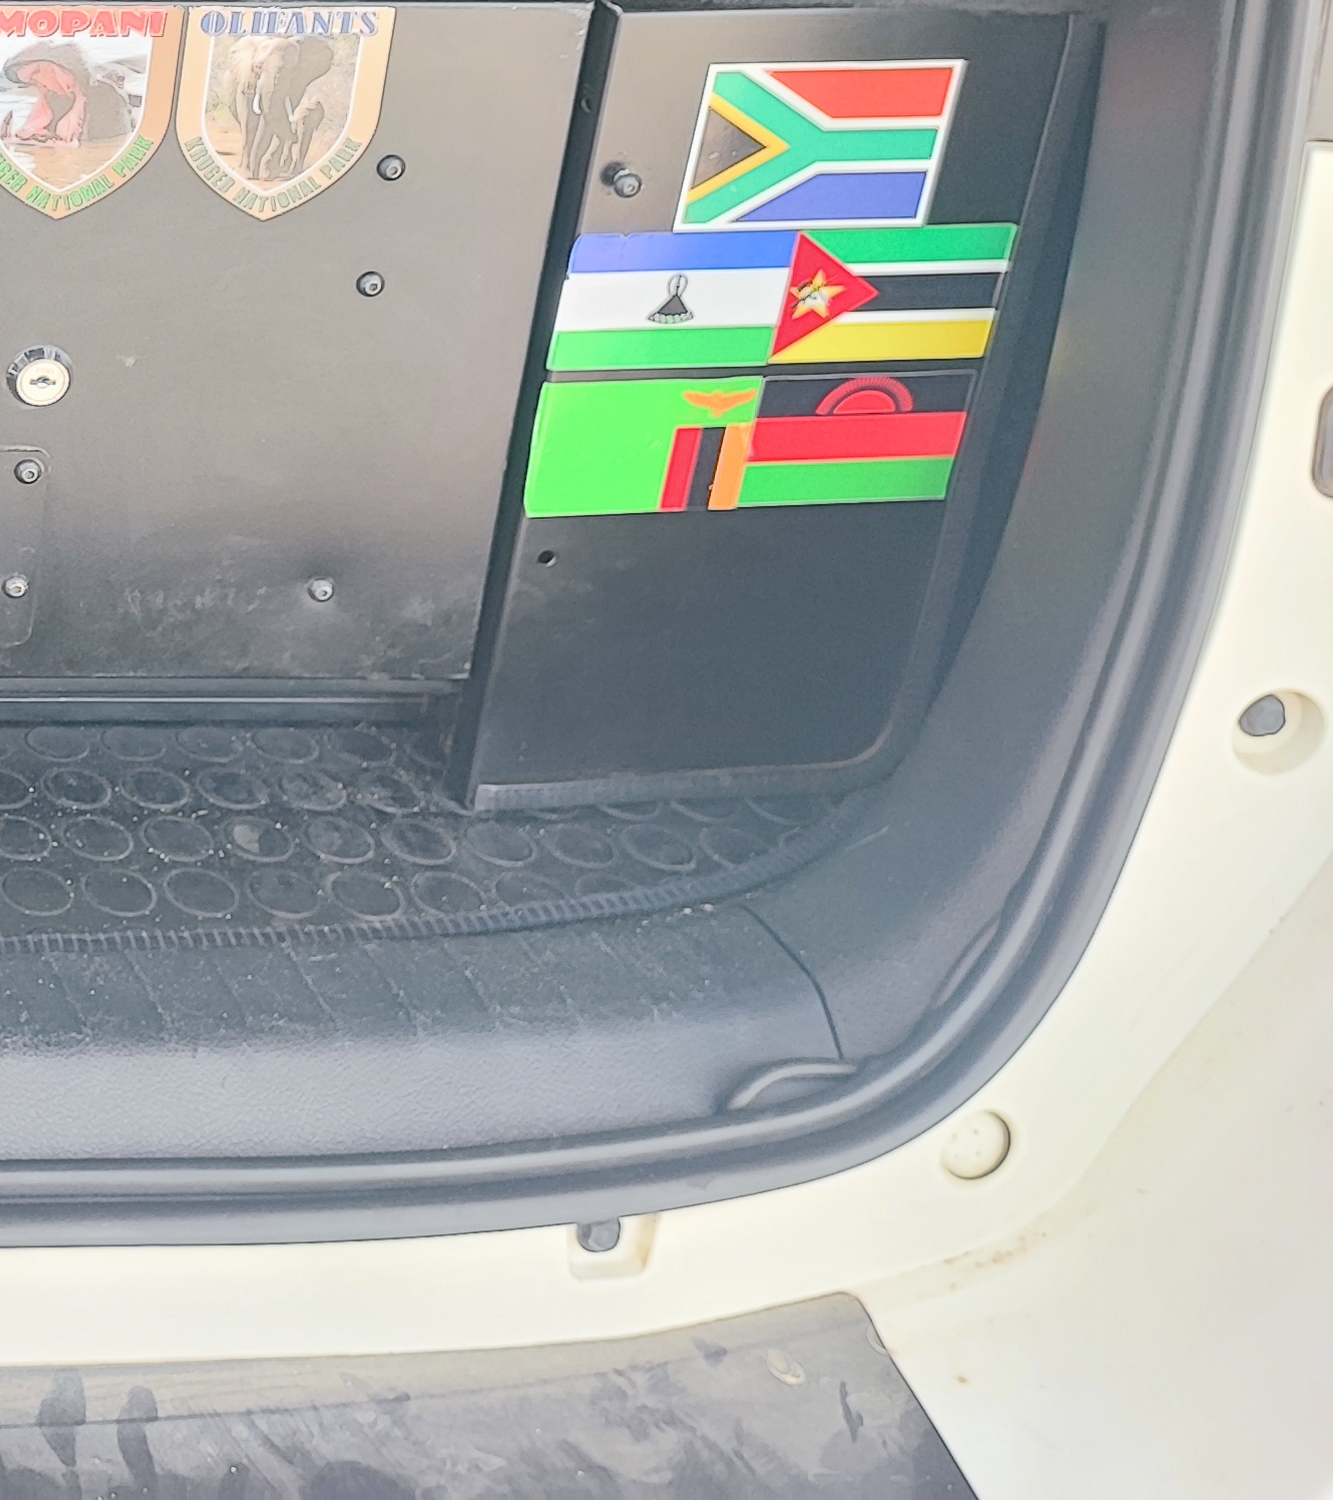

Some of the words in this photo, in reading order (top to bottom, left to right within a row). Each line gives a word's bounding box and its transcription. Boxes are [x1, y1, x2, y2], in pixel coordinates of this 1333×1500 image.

[199, 8, 380, 37] OLIFANTS
[26, 173, 115, 212] NATIONAL
[111, 134, 154, 178] PARK
[184, 136, 236, 194] KRUGER
[232, 176, 322, 213] NATIONAL
[319, 137, 363, 180] PARK
